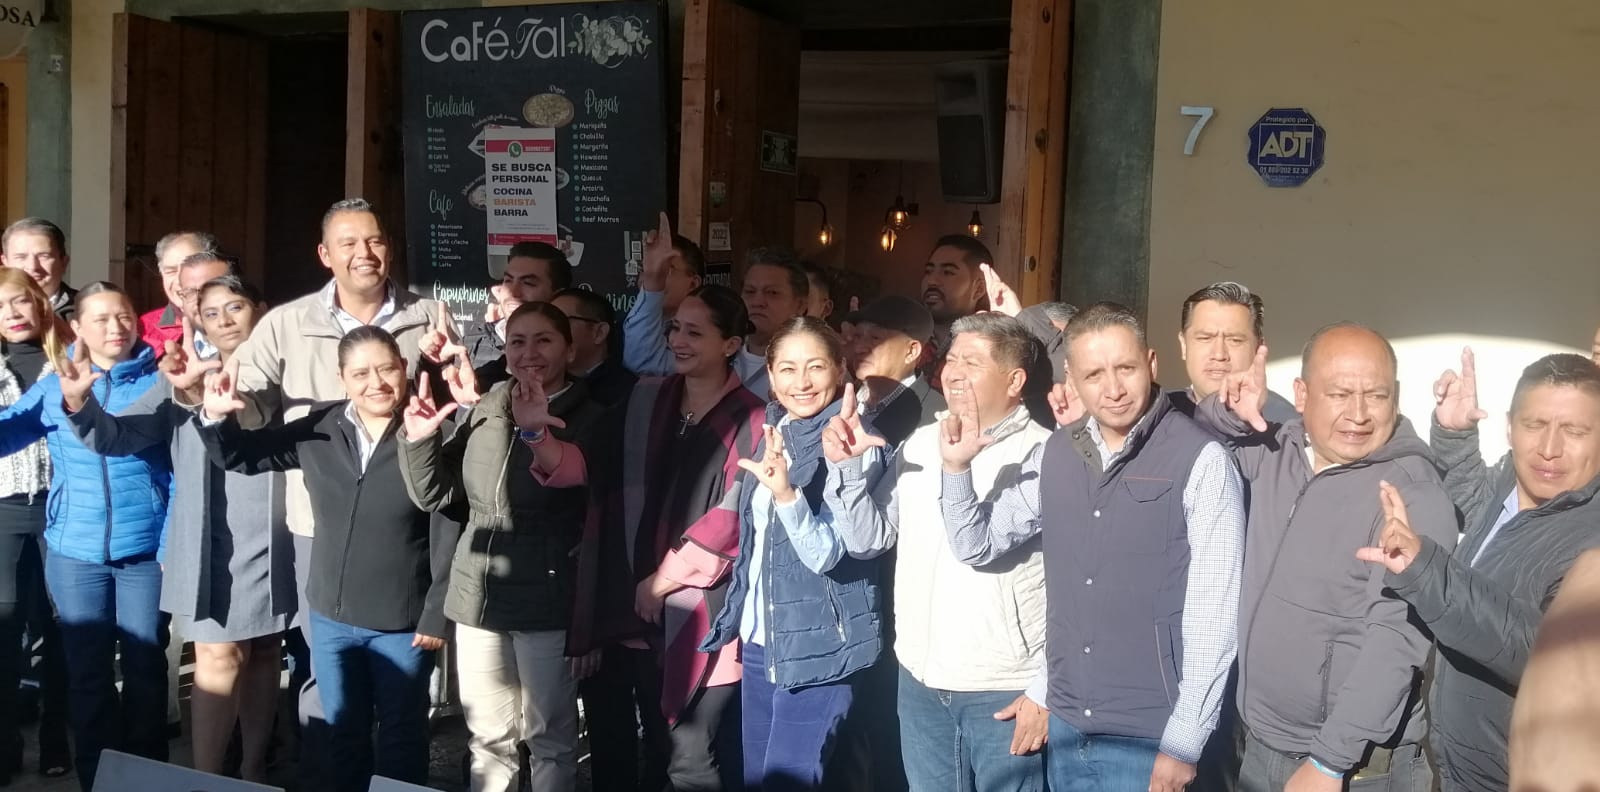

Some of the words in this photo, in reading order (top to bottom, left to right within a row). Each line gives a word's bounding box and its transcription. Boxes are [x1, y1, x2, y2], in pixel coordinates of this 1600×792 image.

[425, 94, 475, 119] Ensaladas
[584, 88, 621, 120] Pizzas
[1297, 117, 1309, 125] por
[1180, 106, 1215, 155] 7
[1259, 131, 1313, 159] ADT
[491, 163, 507, 172] SE
[511, 163, 553, 172] BUSCA
[491, 175, 549, 184] PERSONAL
[493, 187, 533, 196] COCINA
[494, 198, 537, 207] BARISTA
[494, 209, 529, 217] BARRA
